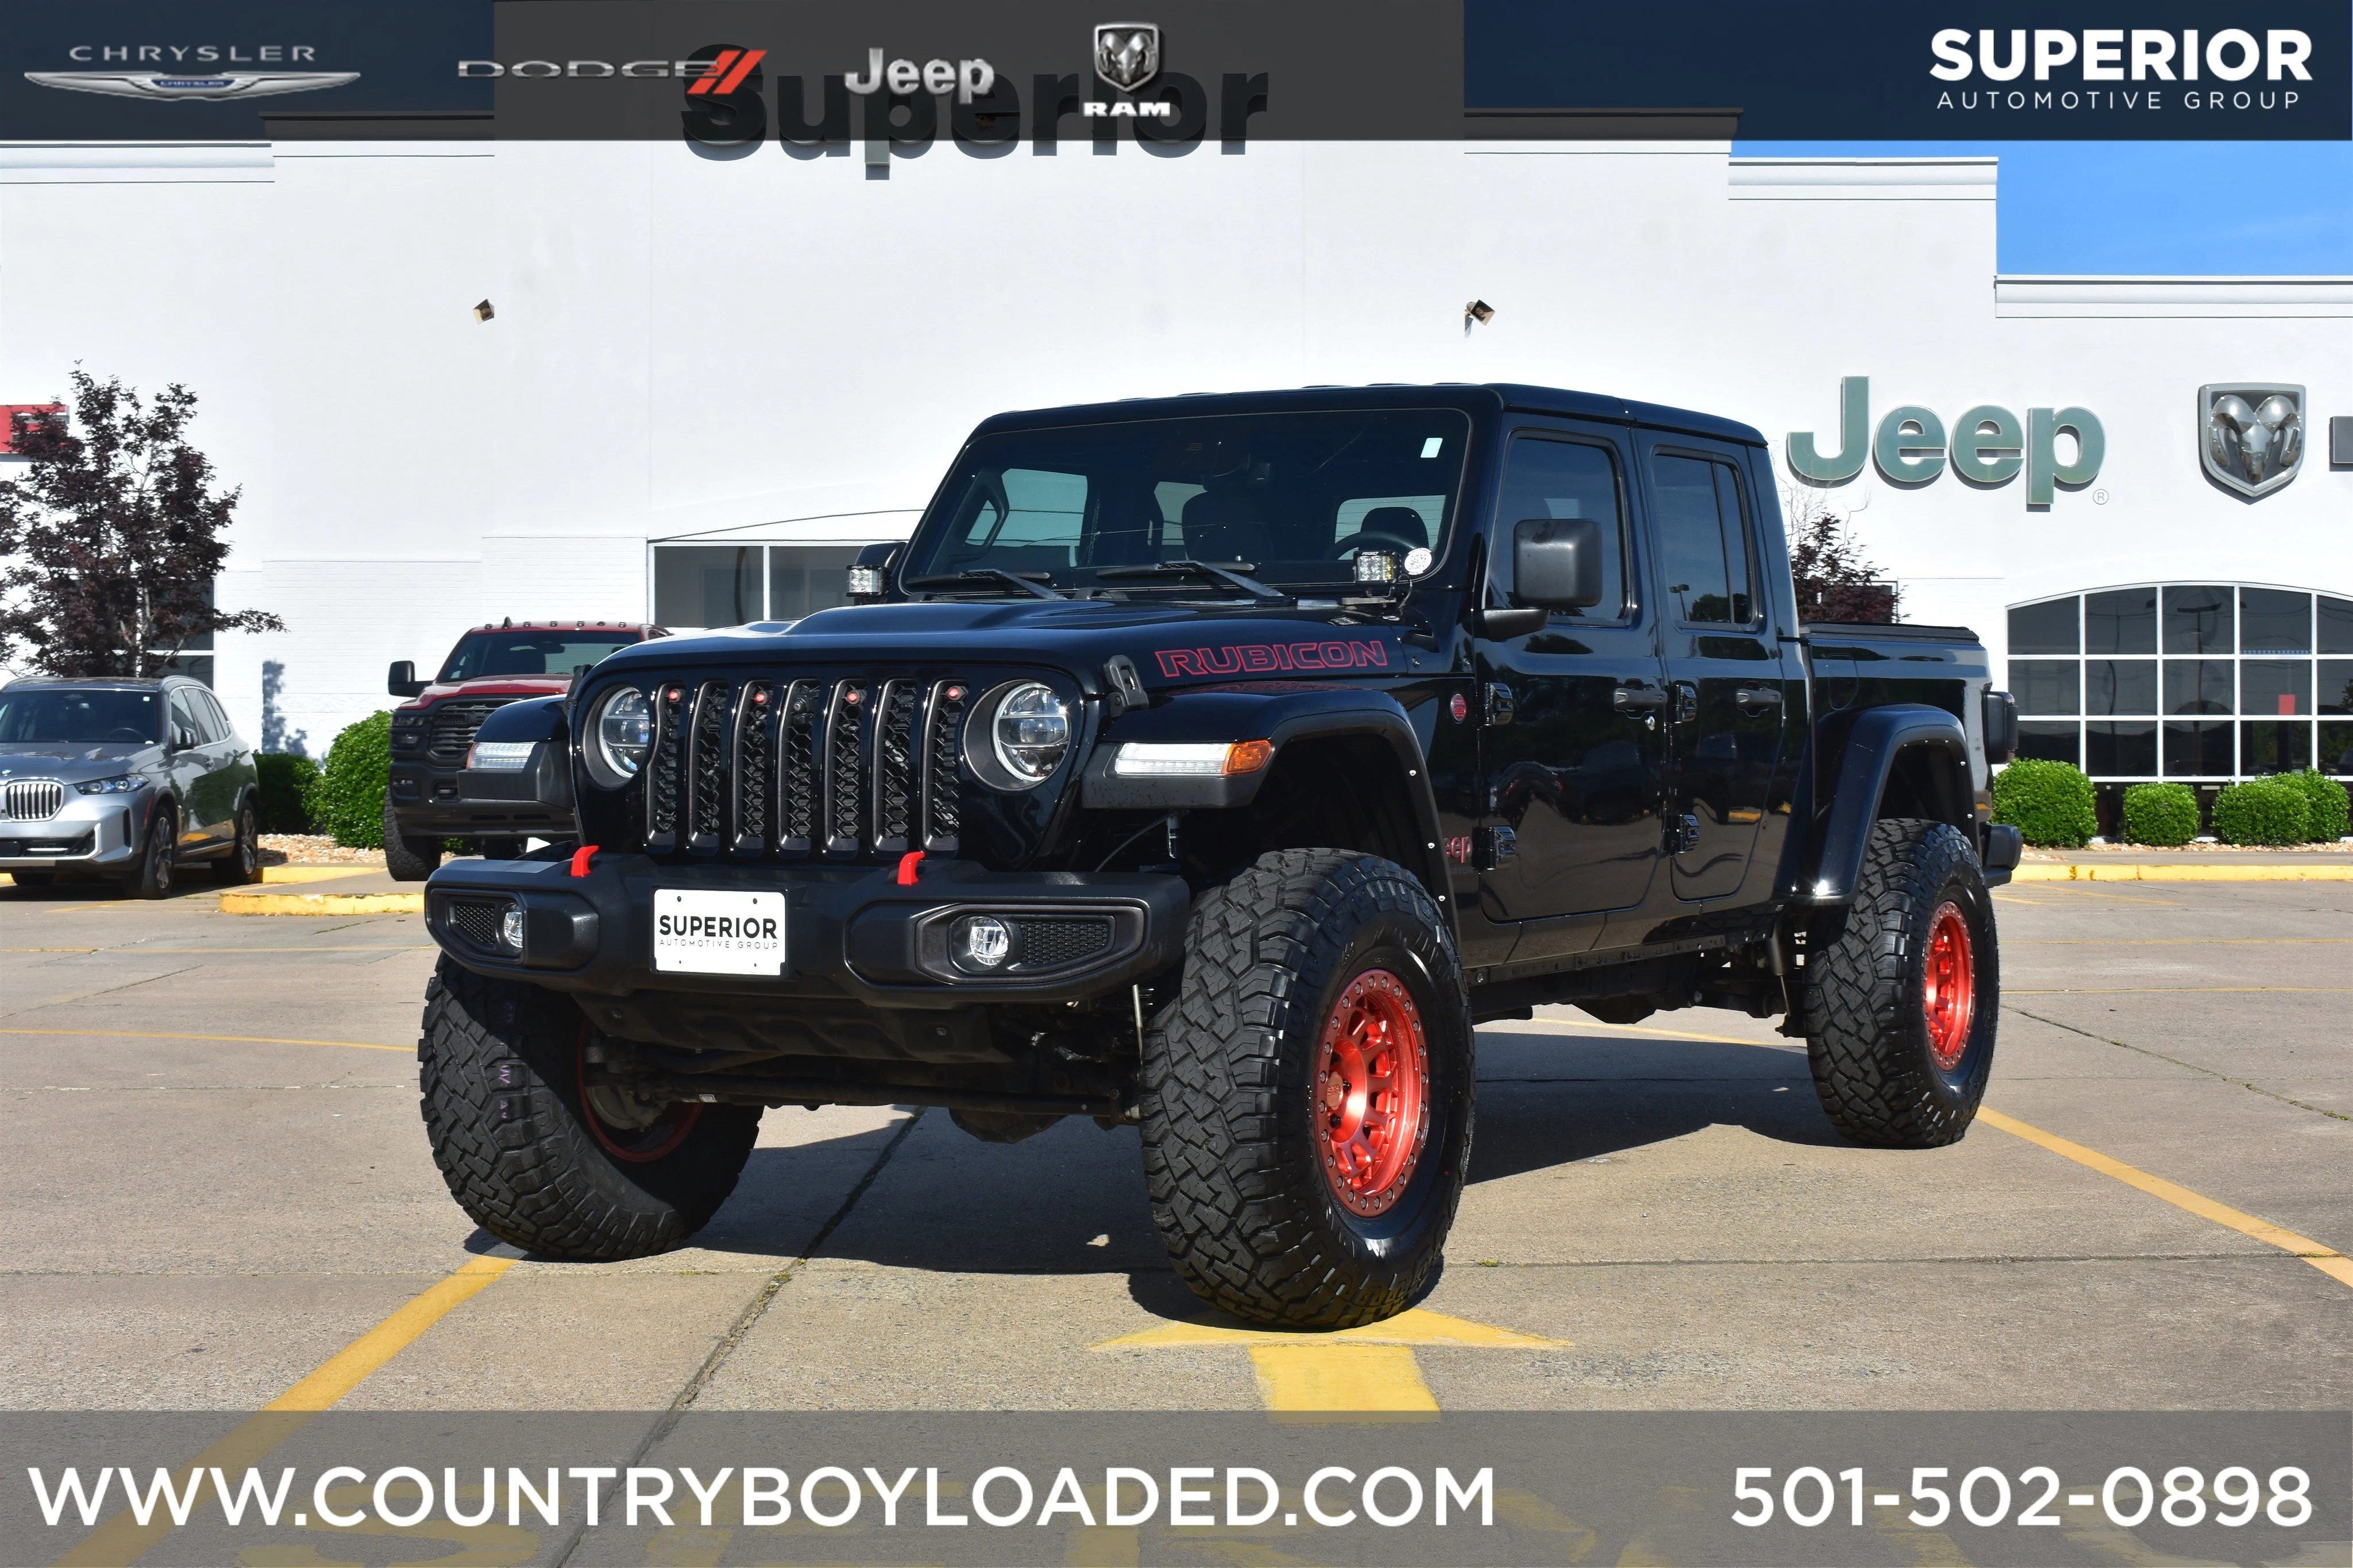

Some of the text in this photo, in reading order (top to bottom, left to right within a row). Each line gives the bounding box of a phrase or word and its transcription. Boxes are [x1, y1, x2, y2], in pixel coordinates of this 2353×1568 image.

[1787, 376, 2106, 504] Jeep
[1154, 640, 1388, 678] RUBICON
[1442, 837, 1472, 864] eep
[659, 914, 778, 939] SUPERIOR
[659, 939, 778, 949] AUTOMOTIVE GROUP
